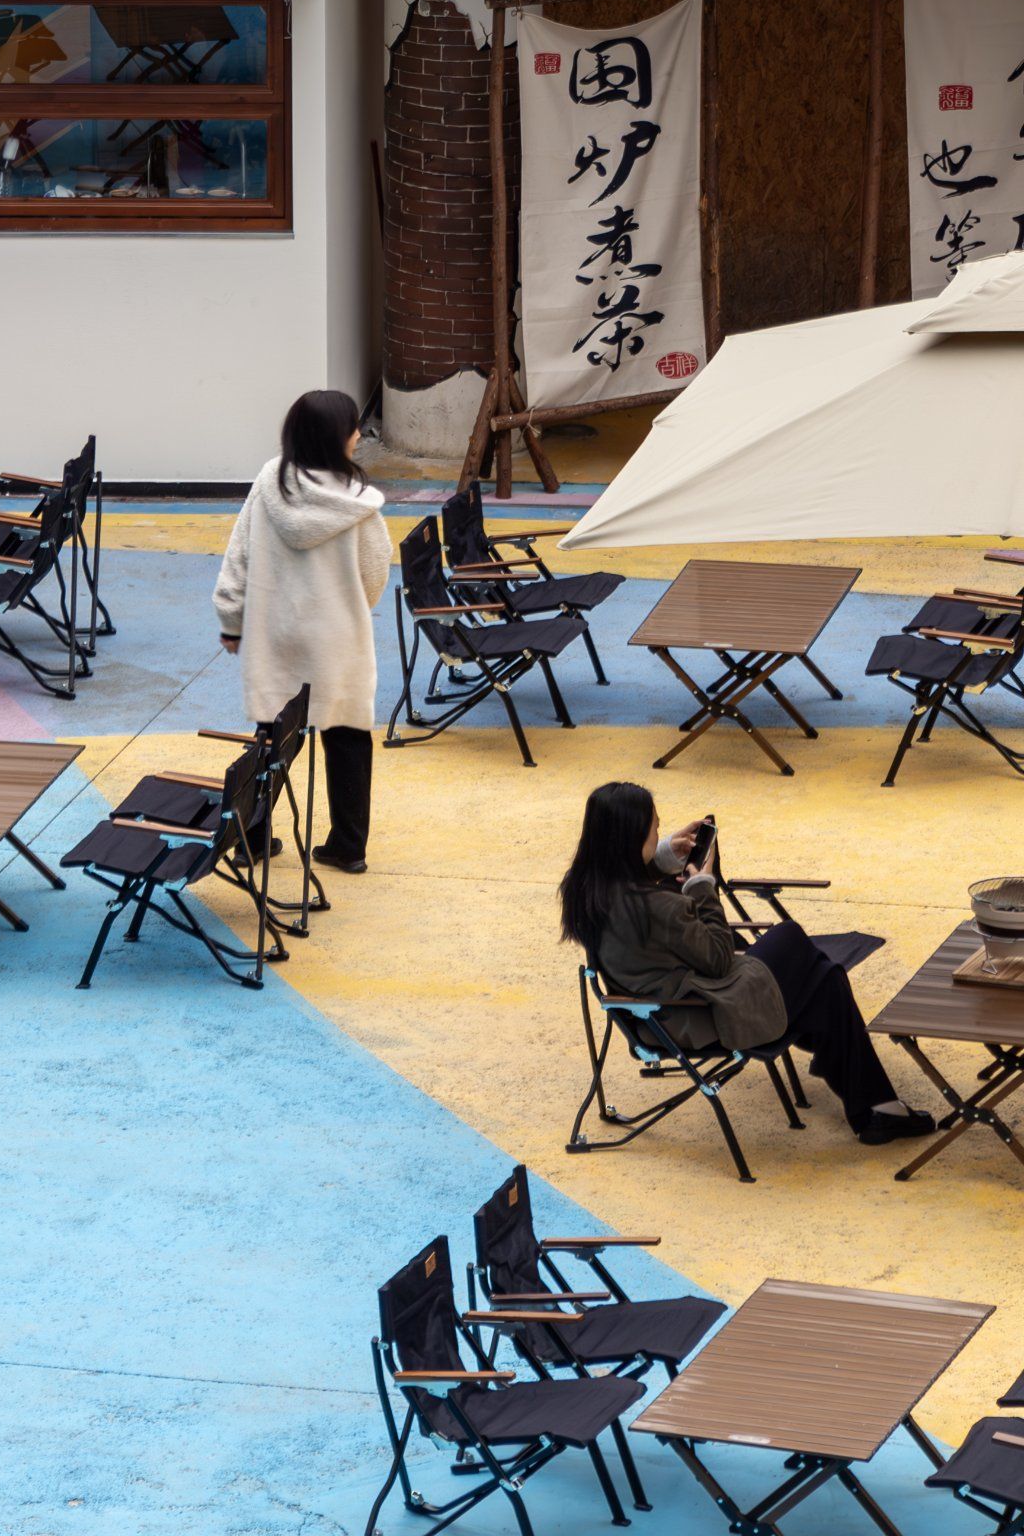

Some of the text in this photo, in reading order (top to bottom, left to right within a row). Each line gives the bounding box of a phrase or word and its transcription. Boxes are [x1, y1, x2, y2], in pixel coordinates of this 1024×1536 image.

[567, 36, 665, 372] 围炉煮茶
[657, 352, 699, 378] 吉祥
